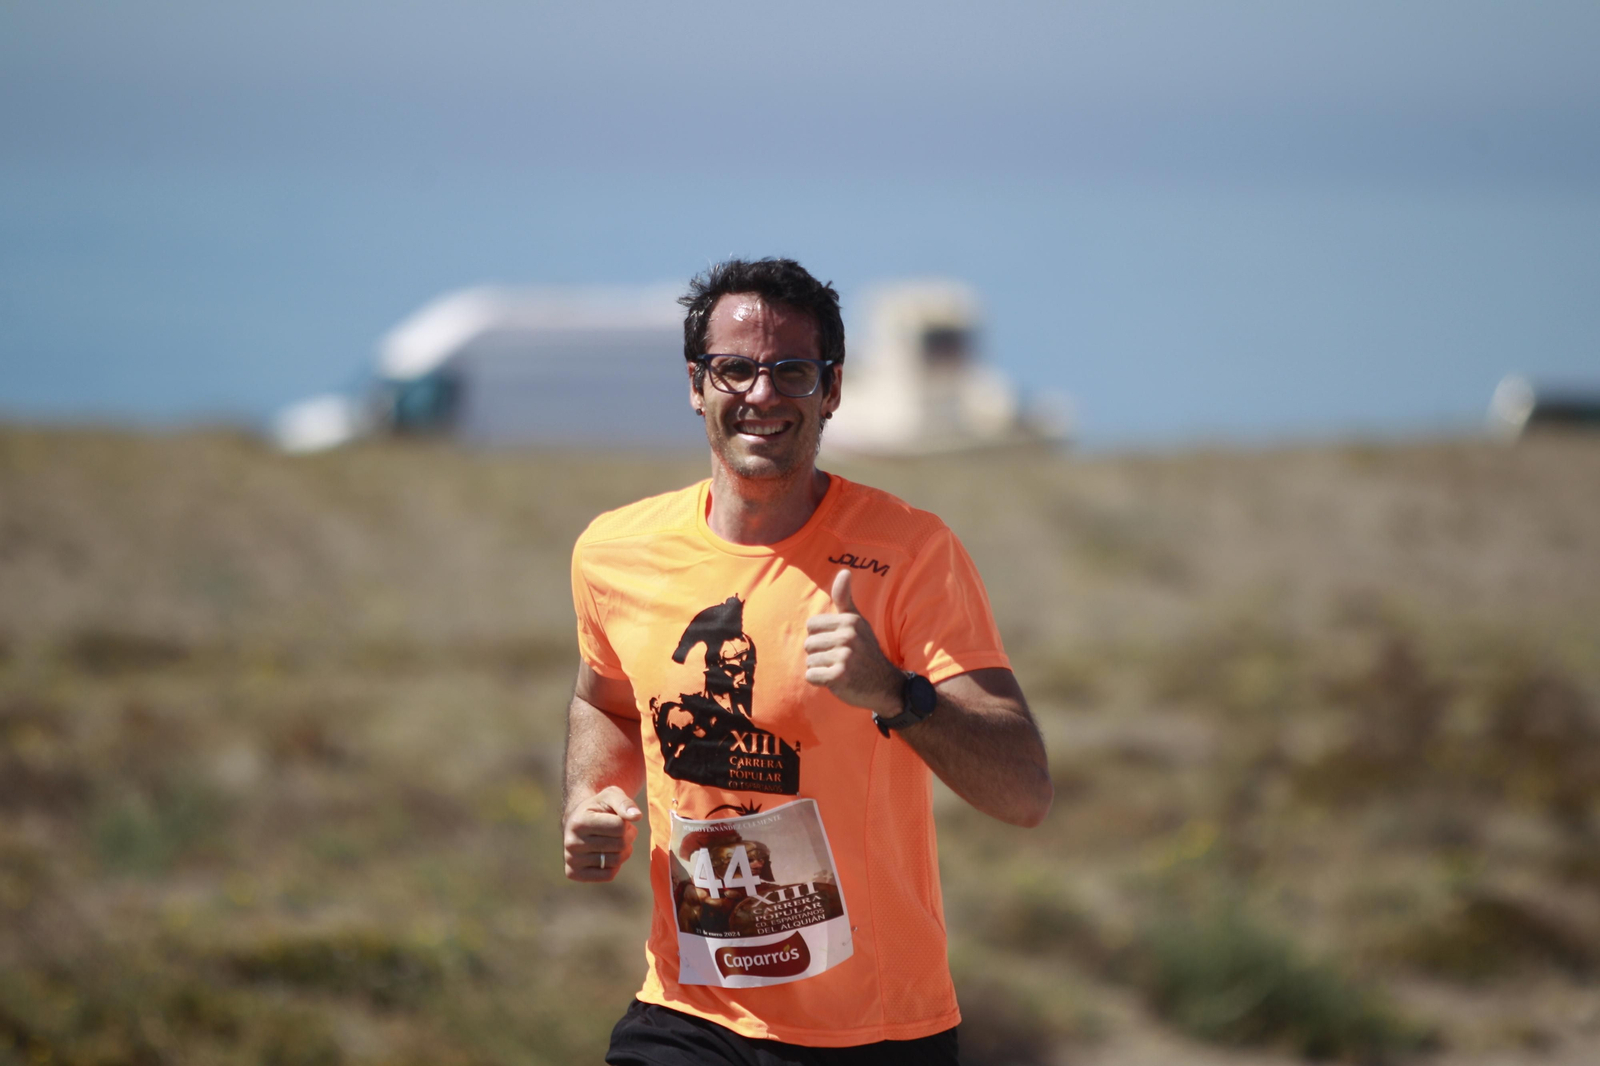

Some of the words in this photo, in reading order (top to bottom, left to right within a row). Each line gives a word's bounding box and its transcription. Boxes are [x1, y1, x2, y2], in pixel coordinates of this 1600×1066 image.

[729, 730, 782, 756] XIII
[729, 756, 783, 769] CARRERA
[729, 769, 782, 782] POPULAR
[694, 844, 761, 899] 44
[752, 881, 818, 907] XIII
[753, 895, 821, 914] CARRERA
[755, 902, 822, 921] POPULAR
[771, 908, 825, 925] ESPARTANOS
[757, 925, 778, 935] DEL
